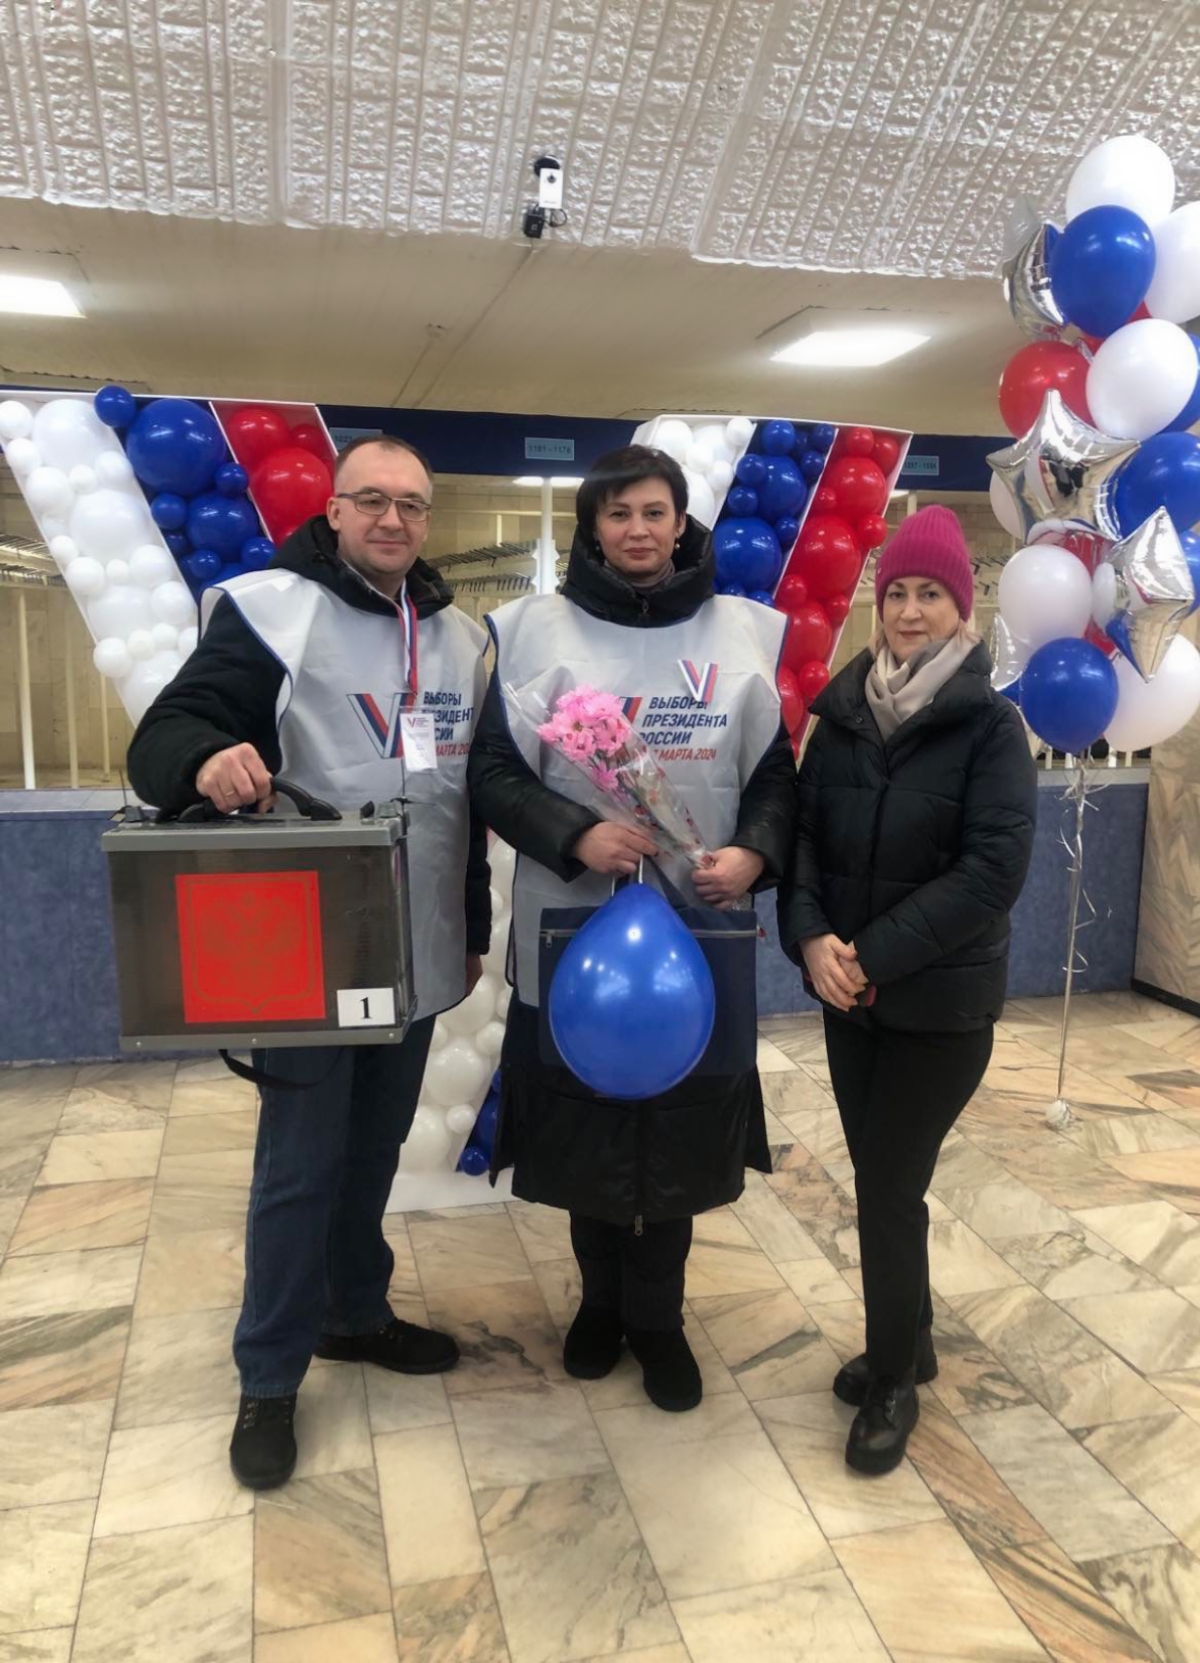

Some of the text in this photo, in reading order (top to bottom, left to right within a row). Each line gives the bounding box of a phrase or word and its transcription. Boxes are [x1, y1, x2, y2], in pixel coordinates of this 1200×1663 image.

[423, 691, 461, 706] ВЫБОРЫ
[421, 707, 475, 725] ЗИДЕНТ
[641, 713, 728, 729] ПРЕЗИДЕНТА
[657, 748, 693, 761] МАРТА
[693, 748, 717, 761] 2024
[360, 996, 374, 1019] 1
